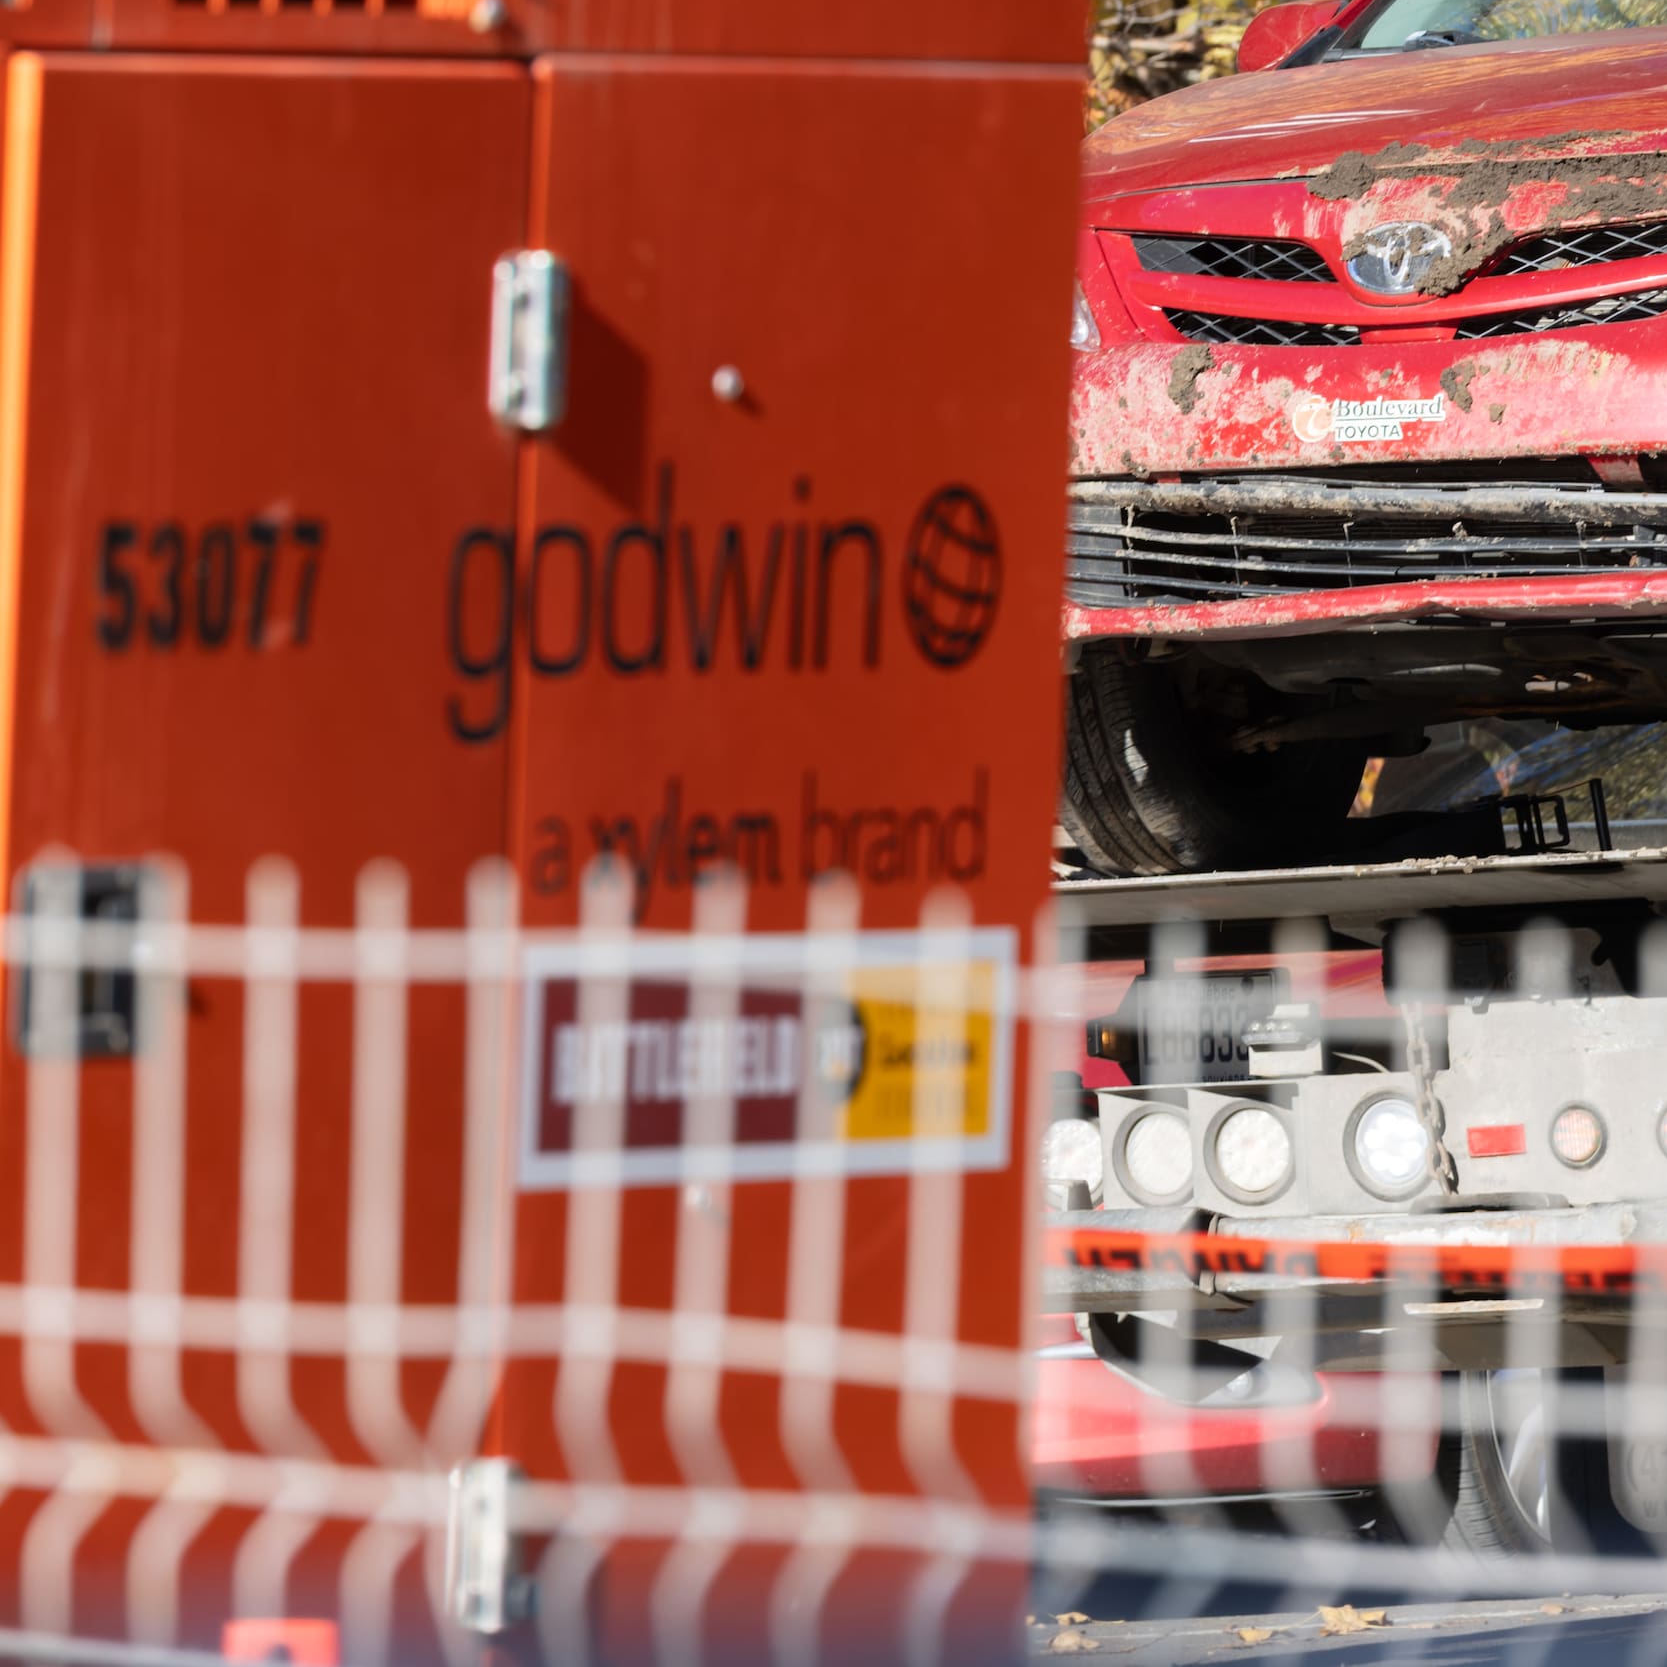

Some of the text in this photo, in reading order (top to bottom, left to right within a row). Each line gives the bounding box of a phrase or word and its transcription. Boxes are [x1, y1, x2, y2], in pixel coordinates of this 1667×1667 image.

[1337, 397, 1442, 417] Boulevard
[1337, 425, 1400, 439] TOYOTA
[96, 517, 327, 650] 53077
[447, 461, 883, 743] godwin
[531, 766, 988, 925] a xylem brand
